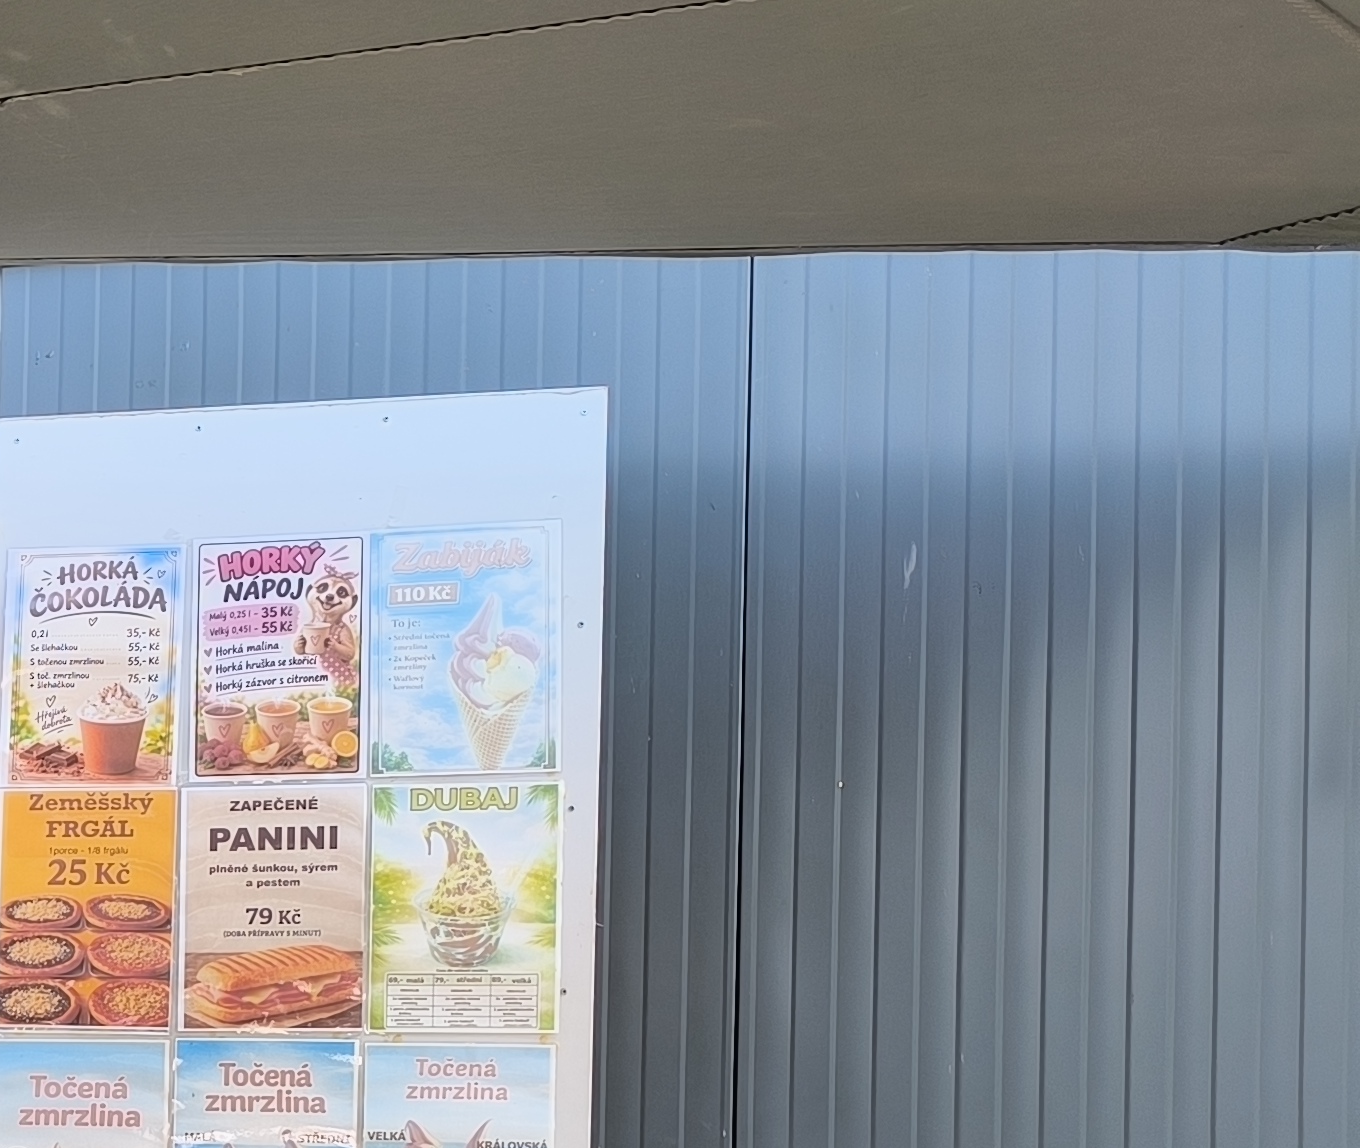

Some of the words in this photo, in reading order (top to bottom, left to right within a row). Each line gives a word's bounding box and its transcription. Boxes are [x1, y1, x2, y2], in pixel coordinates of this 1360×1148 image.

[57, 556, 138, 585] HORKÁ
[217, 541, 326, 582] HORKÝ
[30, 581, 167, 617] ČOKOLÁDA
[223, 576, 304, 602] NÁPOJ
[396, 587, 425, 602] 110
[261, 607, 277, 617] 35
[261, 622, 277, 633] 55
[216, 645, 243, 657] Horká
[247, 641, 279, 652] malina
[216, 662, 243, 674] Horká
[246, 659, 276, 669] hruška
[288, 656, 317, 665] skořicí
[216, 679, 242, 692] Horký
[246, 677, 276, 688] zázvor
[287, 674, 328, 684] citronem
[230, 797, 318, 811] ZAPEČENÉ
[409, 787, 518, 811] DUBAJ
[46, 816, 133, 838] FRGÁL
[210, 826, 338, 851] PANINI
[48, 859, 87, 885] 25
[94, 863, 130, 884] Kč
[210, 865, 248, 875] plněné
[302, 864, 337, 874] sýrem
[257, 880, 300, 888] pestem
[246, 908, 272, 924] 79
[219, 1062, 311, 1088] Točená
[416, 1058, 496, 1079] Točená
[30, 1075, 128, 1100] Točená
[406, 1083, 508, 1102] zmrzlina
[205, 1090, 326, 1115] zmrzlina
[19, 1104, 141, 1129] zmrzlina
[368, 1129, 406, 1141] VELKÁ
